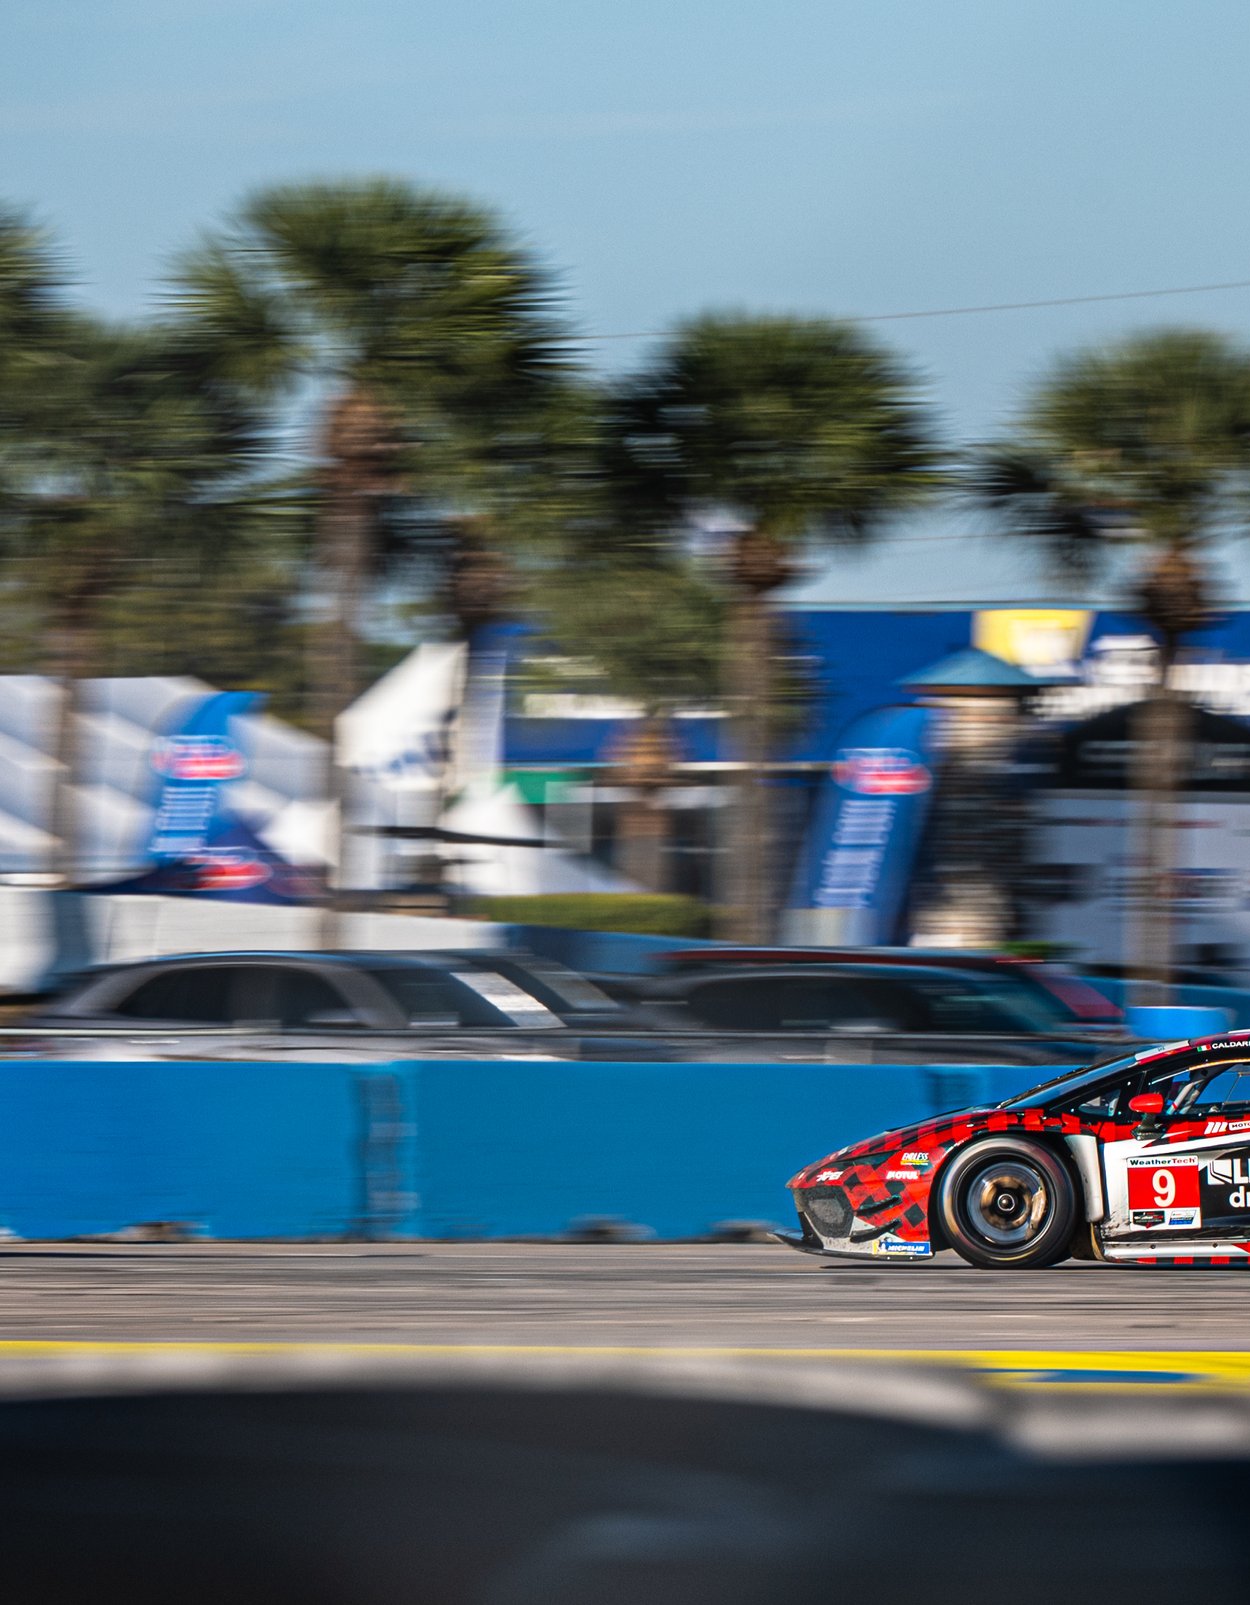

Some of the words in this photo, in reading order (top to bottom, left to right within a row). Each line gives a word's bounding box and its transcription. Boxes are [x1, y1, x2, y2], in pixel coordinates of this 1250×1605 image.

[1129, 1157, 1196, 1166] WeatherTech
[886, 1171, 919, 1180] MOTUL
[1152, 1169, 1176, 1207] 9
